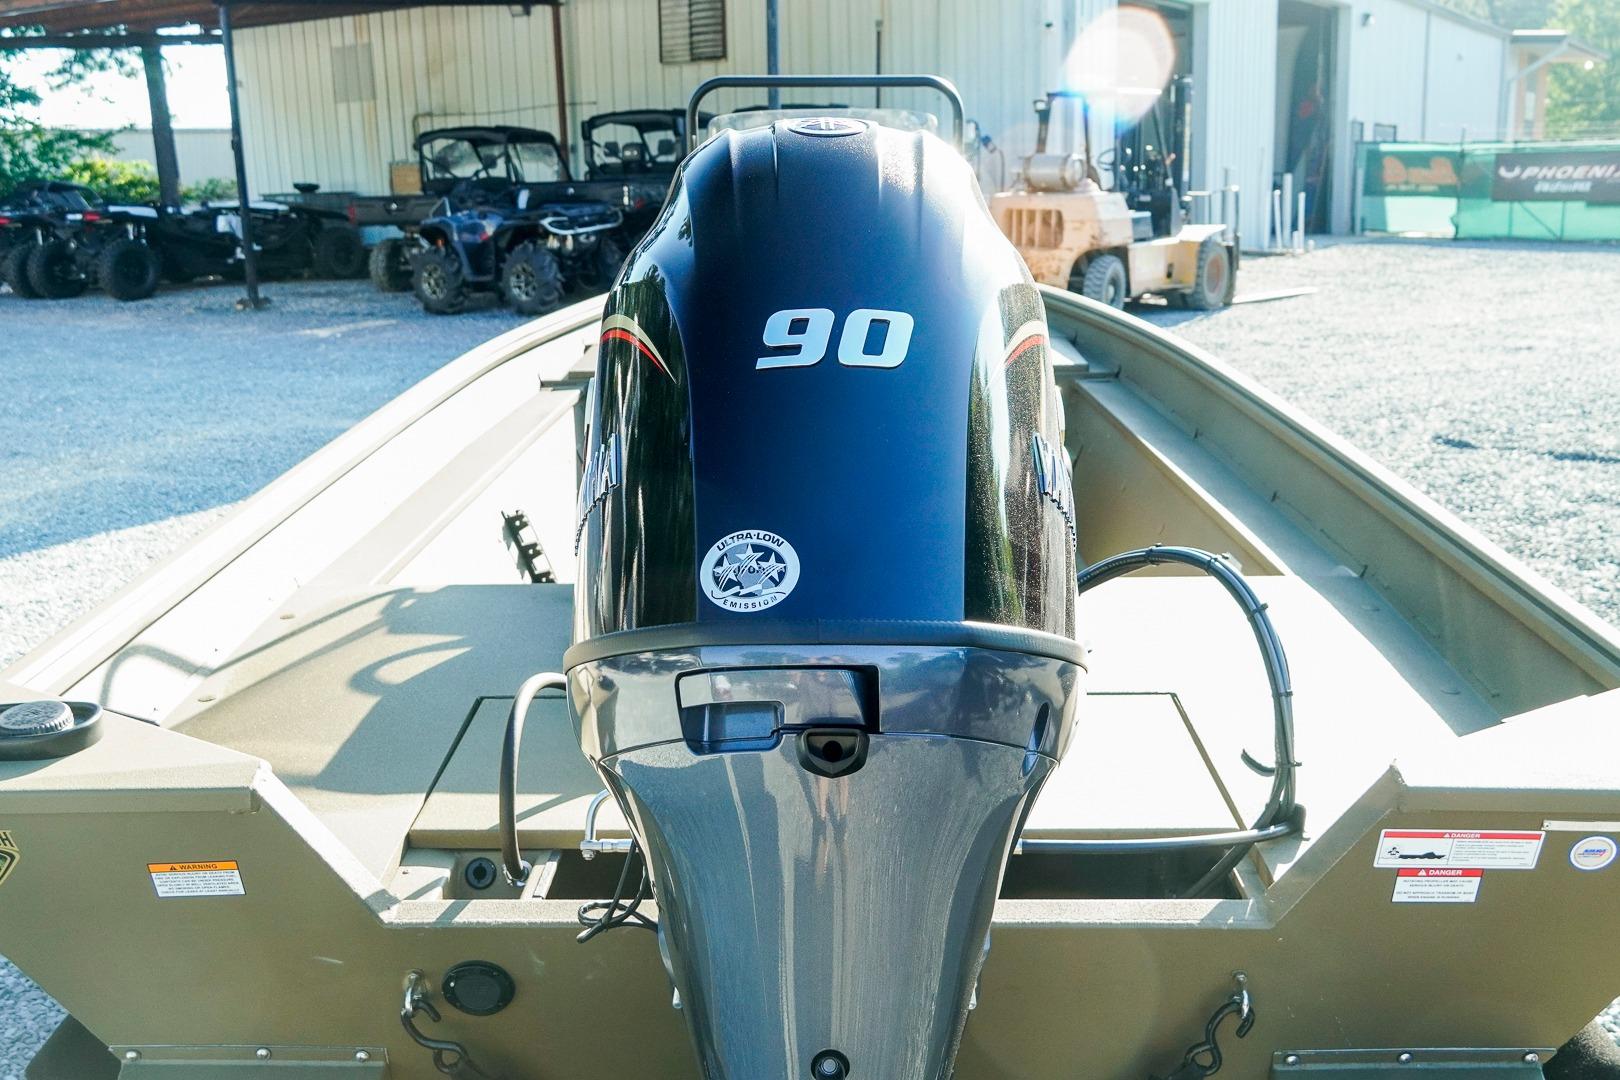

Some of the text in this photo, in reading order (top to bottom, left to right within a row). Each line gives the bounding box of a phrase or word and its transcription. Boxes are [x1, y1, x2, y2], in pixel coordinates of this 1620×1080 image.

[755, 308, 915, 370] 90
[722, 595, 778, 610] EMISSION
[179, 863, 218, 871] WARNING
